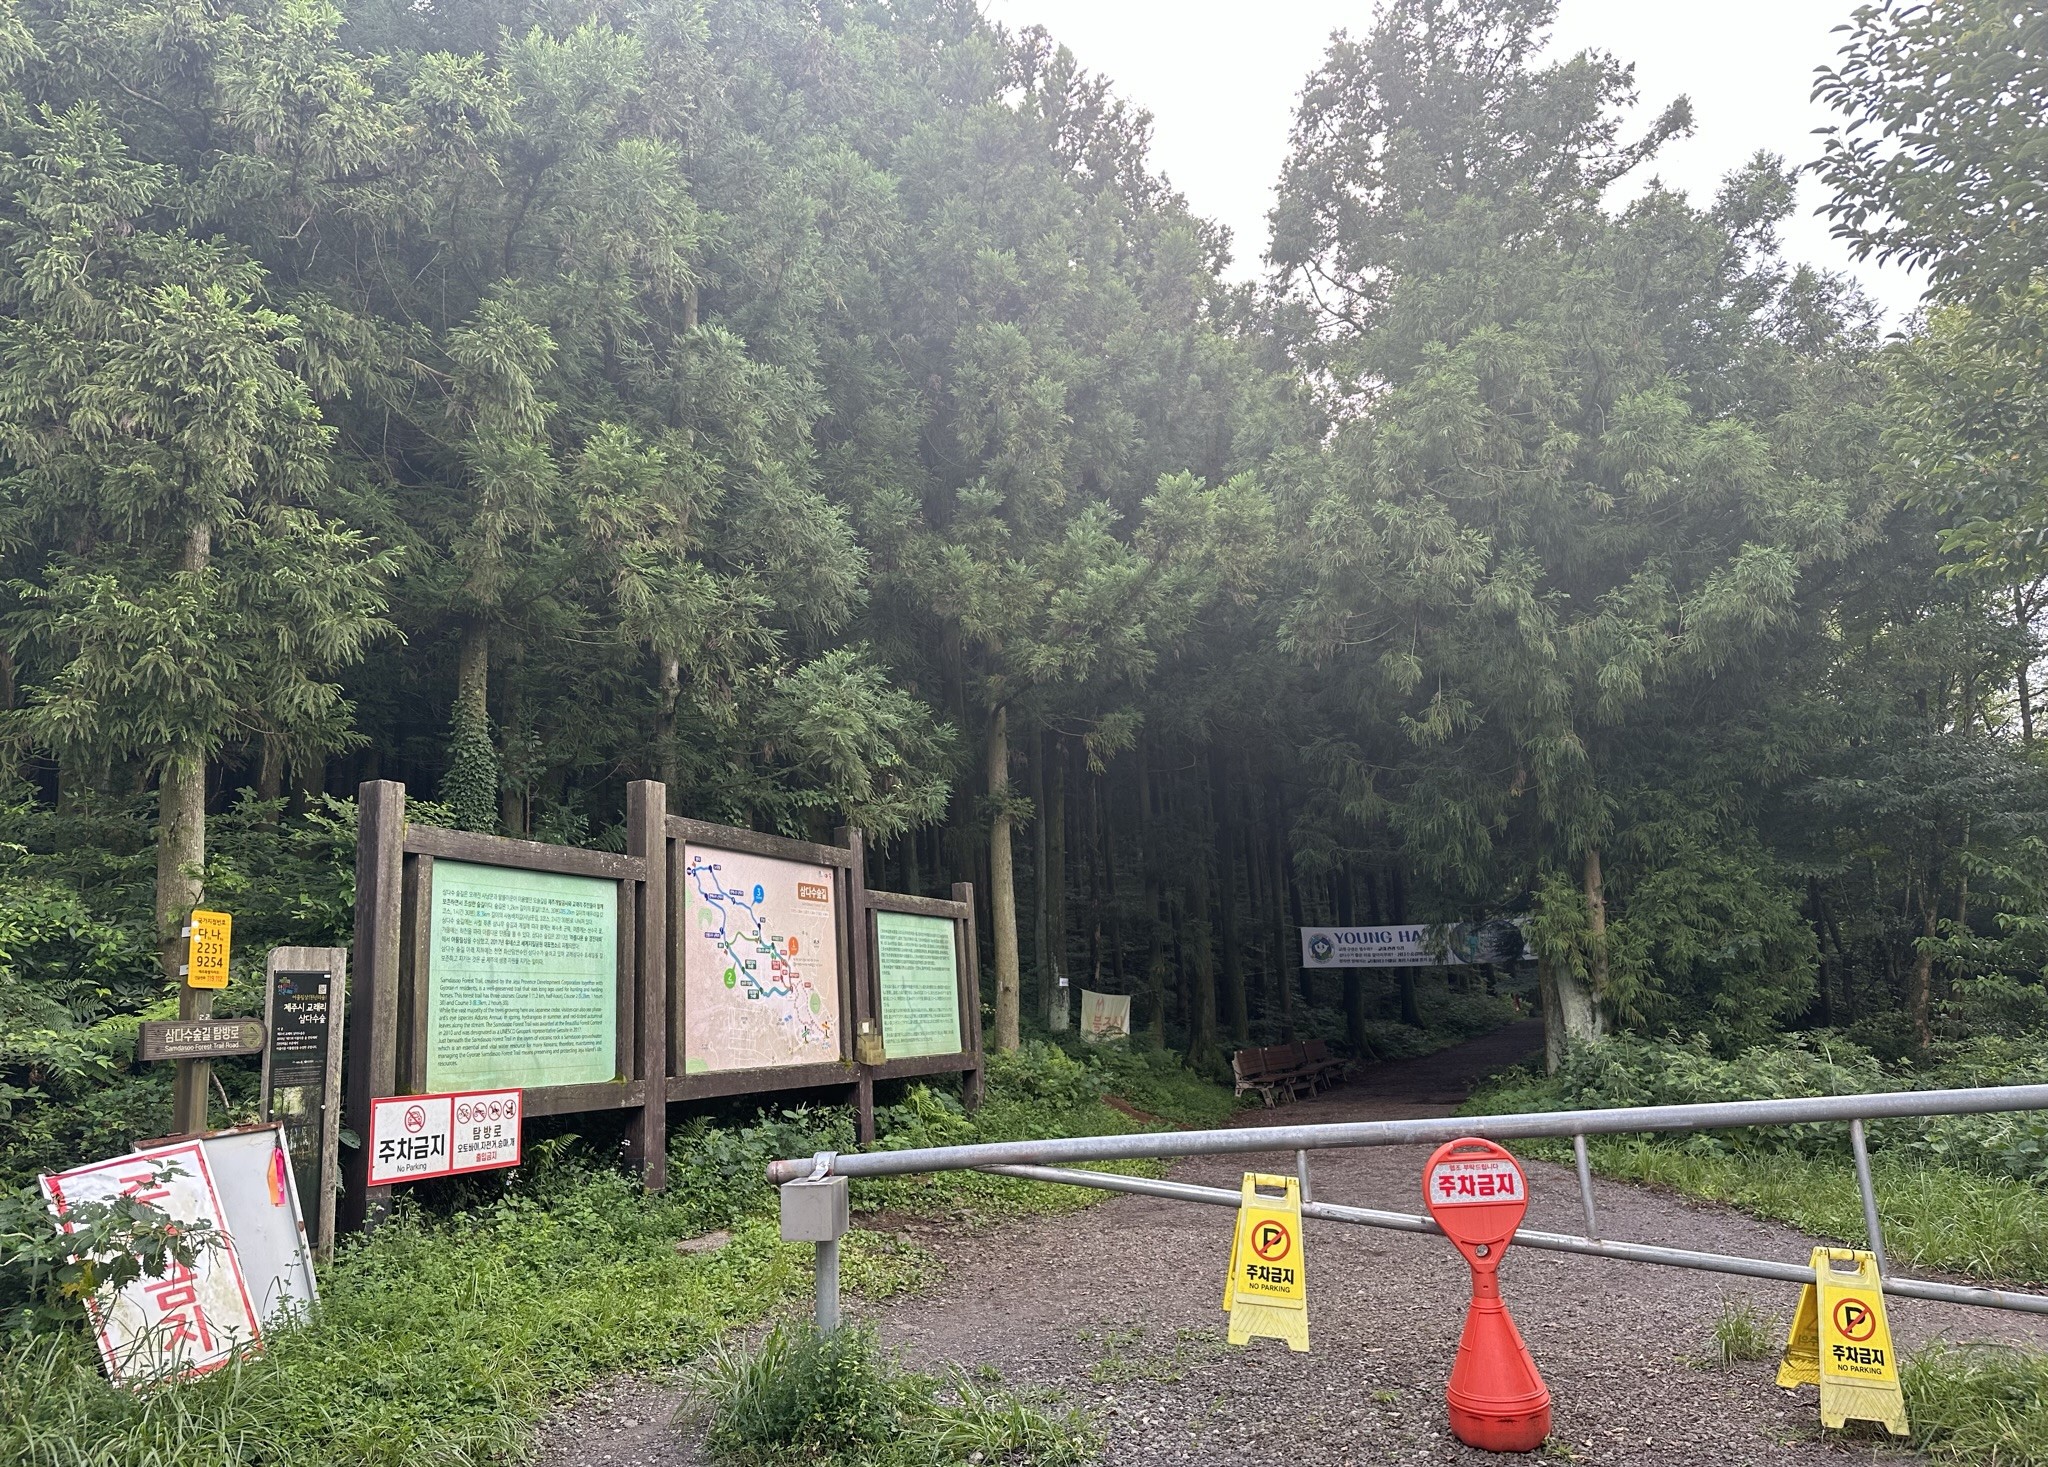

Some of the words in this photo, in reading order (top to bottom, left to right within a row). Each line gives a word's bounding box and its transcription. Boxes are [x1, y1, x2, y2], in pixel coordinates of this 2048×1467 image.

[800, 886, 826, 900] 삼다수숲길
[198, 928, 208, 939] 다
[212, 929, 221, 940] 나
[1334, 931, 1392, 944] YOUNG
[1398, 930, 1422, 942] HA
[197, 942, 223, 954] 2251
[197, 955, 223, 968] 9254
[284, 1002, 305, 1012] 제주시
[306, 1002, 326, 1012] 교래리
[299, 1014, 326, 1024] 삼다수숲
[165, 1027, 211, 1043] 삼다수숲길
[213, 1026, 239, 1040] 탐방로
[378, 1134, 445, 1164] 주차금지
[476, 1153, 497, 1162] 출입금지
[406, 1162, 427, 1172] Parking
[1439, 1173, 1515, 1197] 주차금지
[1247, 1264, 1294, 1285] 주차금지
[1261, 1284, 1290, 1293] PARKING
[1833, 1345, 1884, 1366] 주차금지
[1850, 1365, 1882, 1375] PARKING
